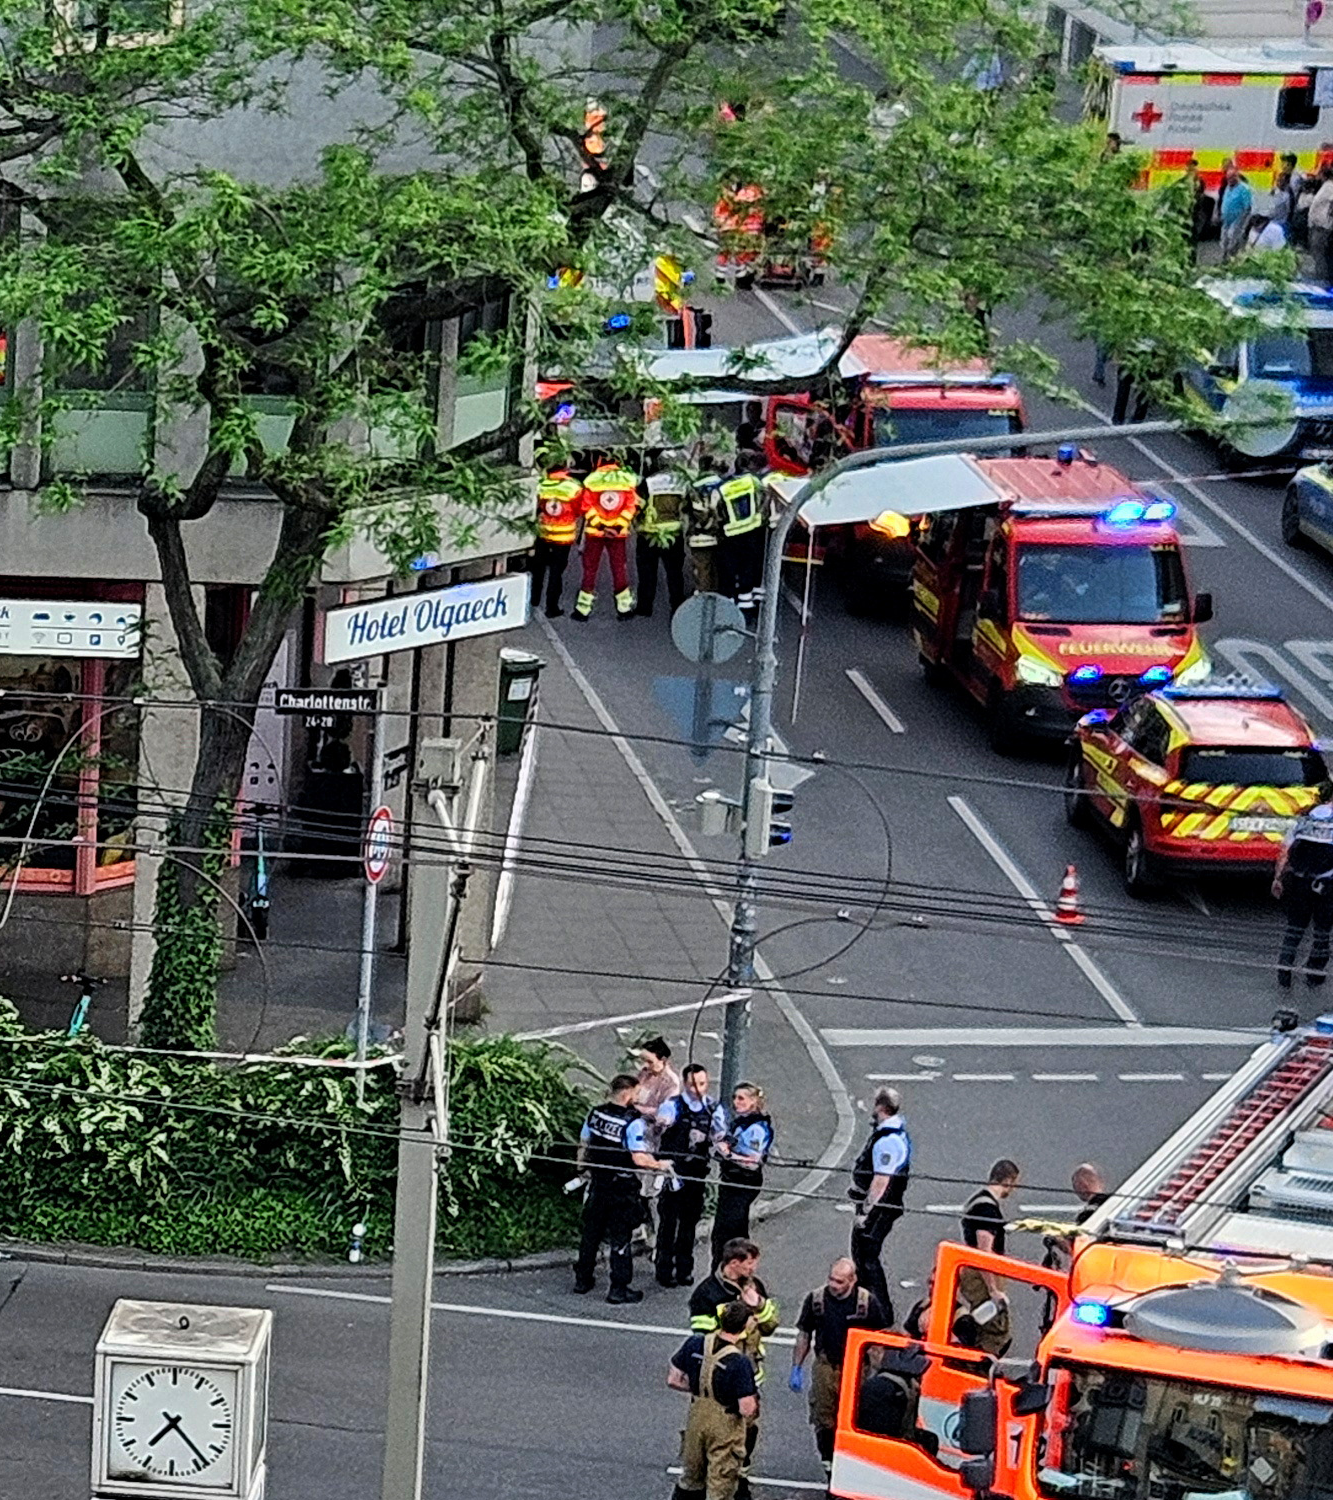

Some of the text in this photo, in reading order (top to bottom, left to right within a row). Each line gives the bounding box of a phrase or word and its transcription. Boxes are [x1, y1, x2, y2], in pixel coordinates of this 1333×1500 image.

[348, 588, 508, 646] Hotel Olgaeck
[280, 694, 371, 710] Charlottenstr.
